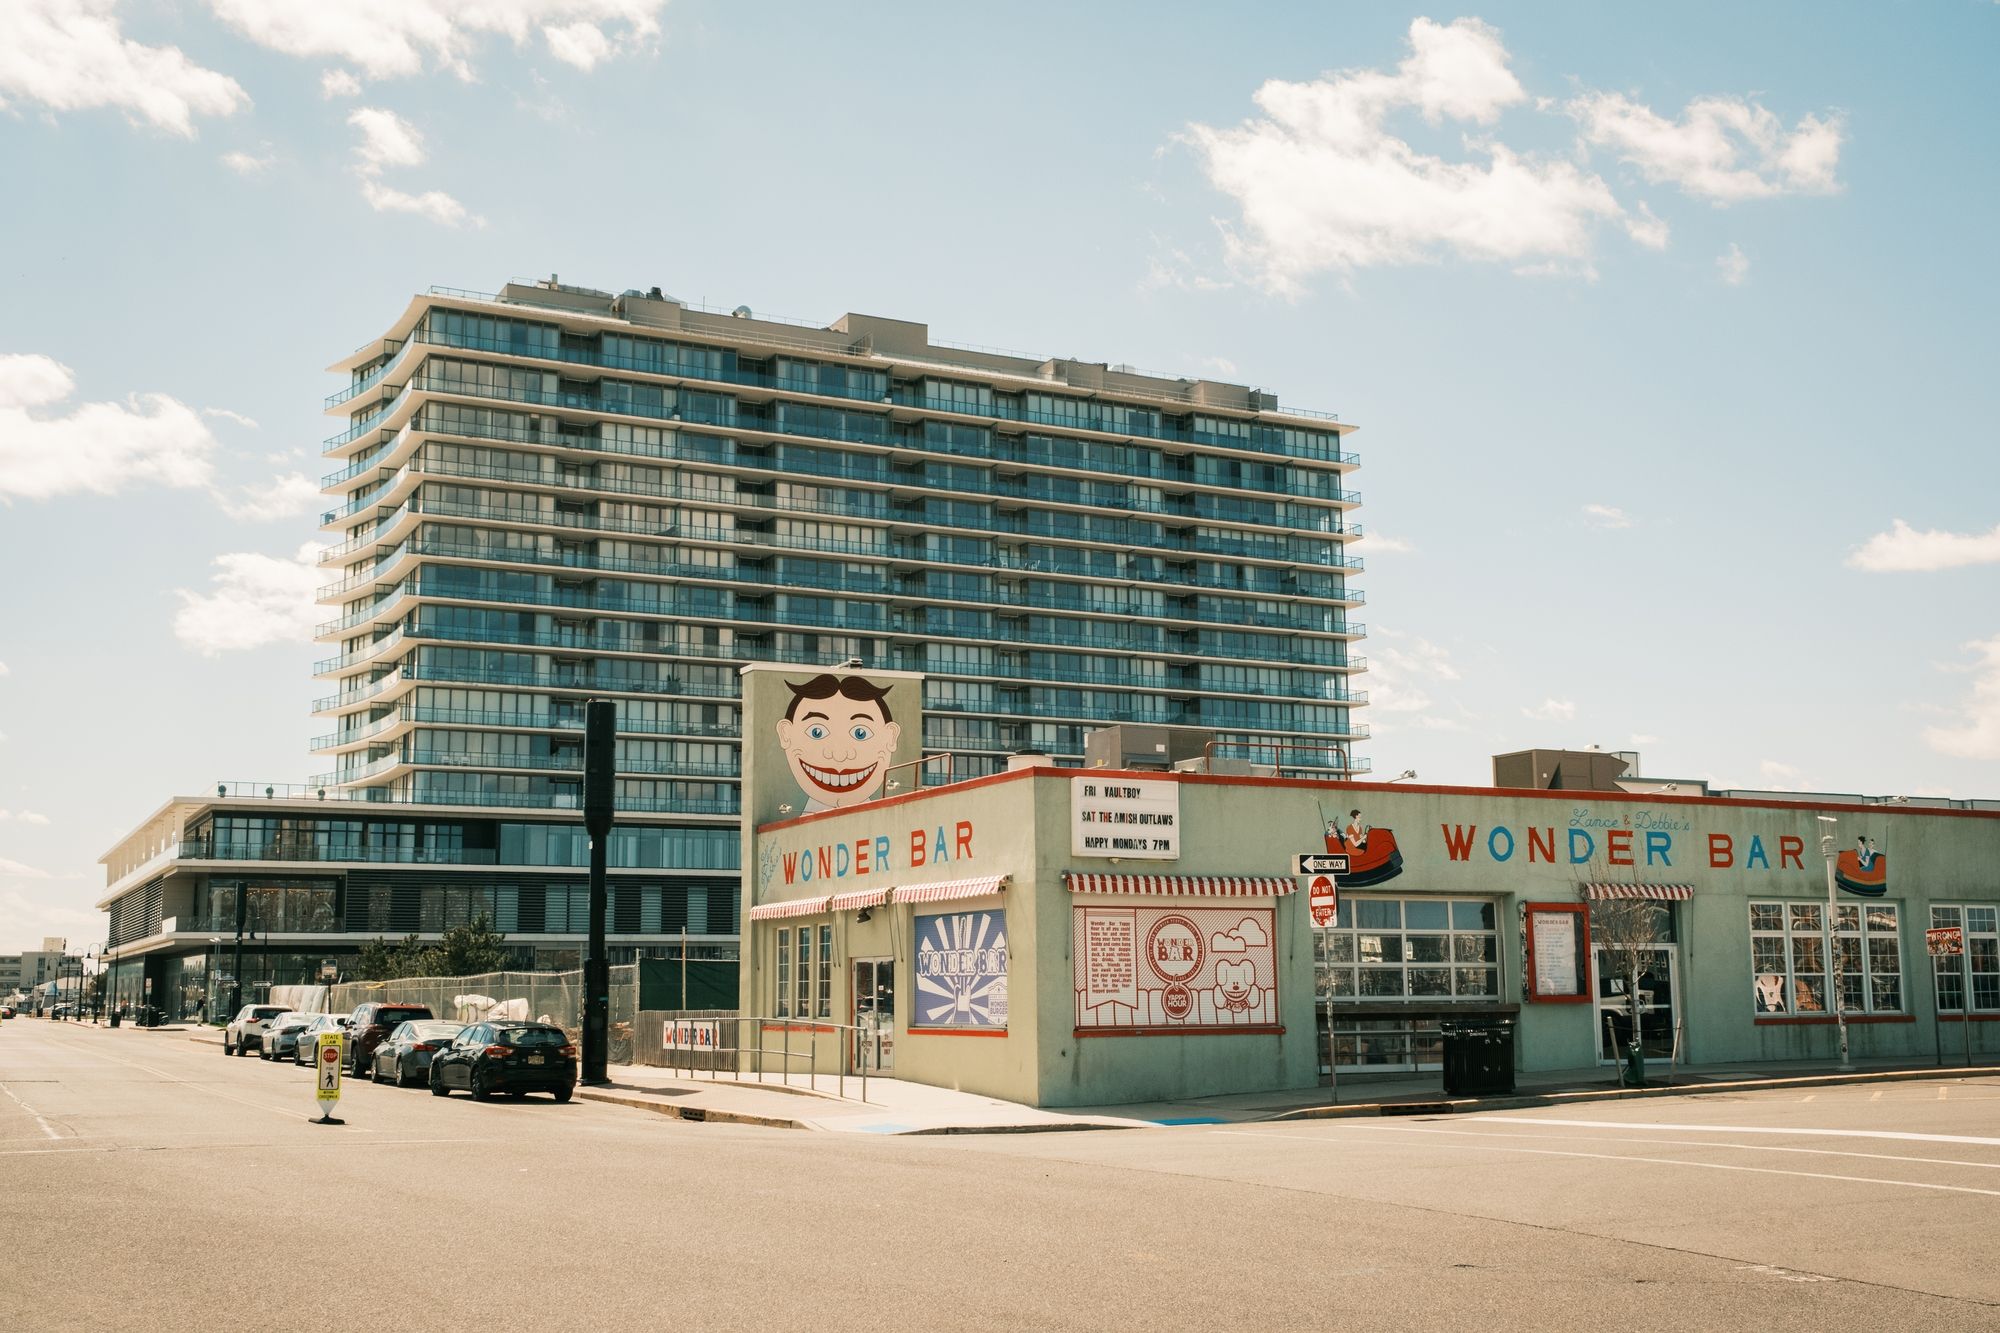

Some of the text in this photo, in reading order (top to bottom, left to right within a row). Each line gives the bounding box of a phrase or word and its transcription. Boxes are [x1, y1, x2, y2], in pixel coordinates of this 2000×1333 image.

[1084, 785, 1141, 799] FRI VAULTBOY
[1082, 811, 1173, 826] SAT THE AMISH OUTLAWS
[1568, 808, 1690, 831] Lance & Debbie's
[1085, 836, 1170, 851] HAPPY MONDAYS 7PM
[1441, 823, 1805, 870] WONDER BAR
[783, 835, 890, 885] WONDER
[911, 820, 973, 868] BAR
[1313, 860, 1343, 868] ONE WAY
[1313, 885, 1331, 894] DO NOT
[1157, 937, 1195, 947] WONDER
[1931, 931, 1960, 941] WRONG
[1157, 946, 1194, 961] BAR
[919, 949, 1007, 976] WONDER BAR
[1168, 1000, 1187, 1008] HOUR
